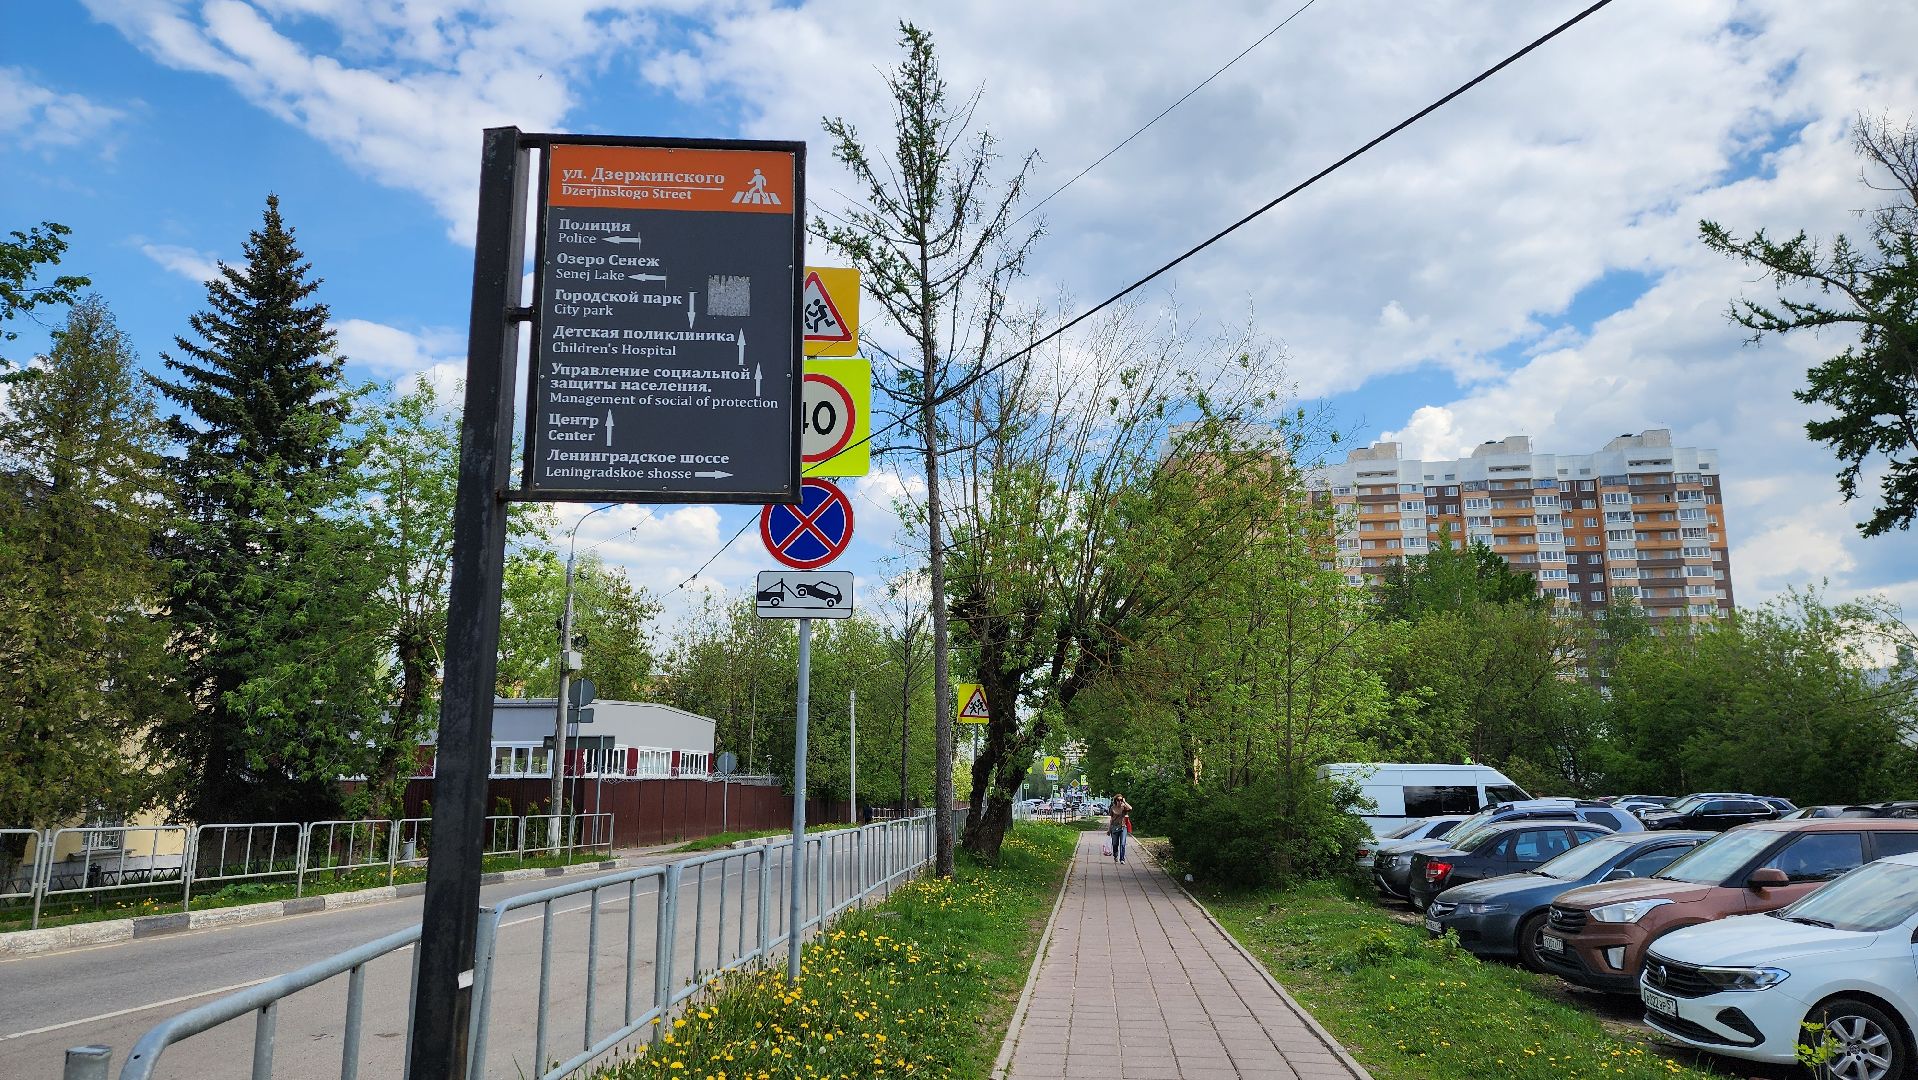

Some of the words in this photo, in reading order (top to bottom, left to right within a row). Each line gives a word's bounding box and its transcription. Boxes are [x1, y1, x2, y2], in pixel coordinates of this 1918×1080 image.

[562, 169, 587, 181] ул.
[591, 167, 725, 184] Дзержинского
[562, 185, 648, 199] Dzerjinskogo
[653, 188, 692, 200] Street
[559, 218, 631, 233] Полиция
[558, 232, 597, 244] Police
[557, 252, 605, 267] Озеро
[608, 254, 660, 267] Сенеж
[556, 268, 590, 281] Senej
[595, 269, 625, 281] Lake
[555, 289, 638, 303] Городской
[643, 294, 682, 306] парк
[554, 304, 579, 316] City
[583, 305, 613, 317] park
[553, 326, 619, 339] Детская
[623, 330, 735, 342] поликлиника
[552, 342, 618, 354] Children's
[622, 344, 676, 357] Hospital
[552, 363, 649, 378] Управление
[654, 368, 750, 380] социальной
[550, 380, 616, 391] защиты
[620, 381, 712, 392] населения.
[550, 392, 635, 406] Management
[639, 395, 653, 405] of
[655, 396, 692, 406] social
[696, 396, 711, 406] of
[712, 397, 778, 409] protection
[549, 413, 599, 428] Центр
[548, 430, 595, 441] Center
[547, 449, 676, 464] Ленинградское
[680, 453, 730, 464] шоссе
[546, 467, 644, 480] Leningradskoe
[648, 468, 691, 479] shosse
